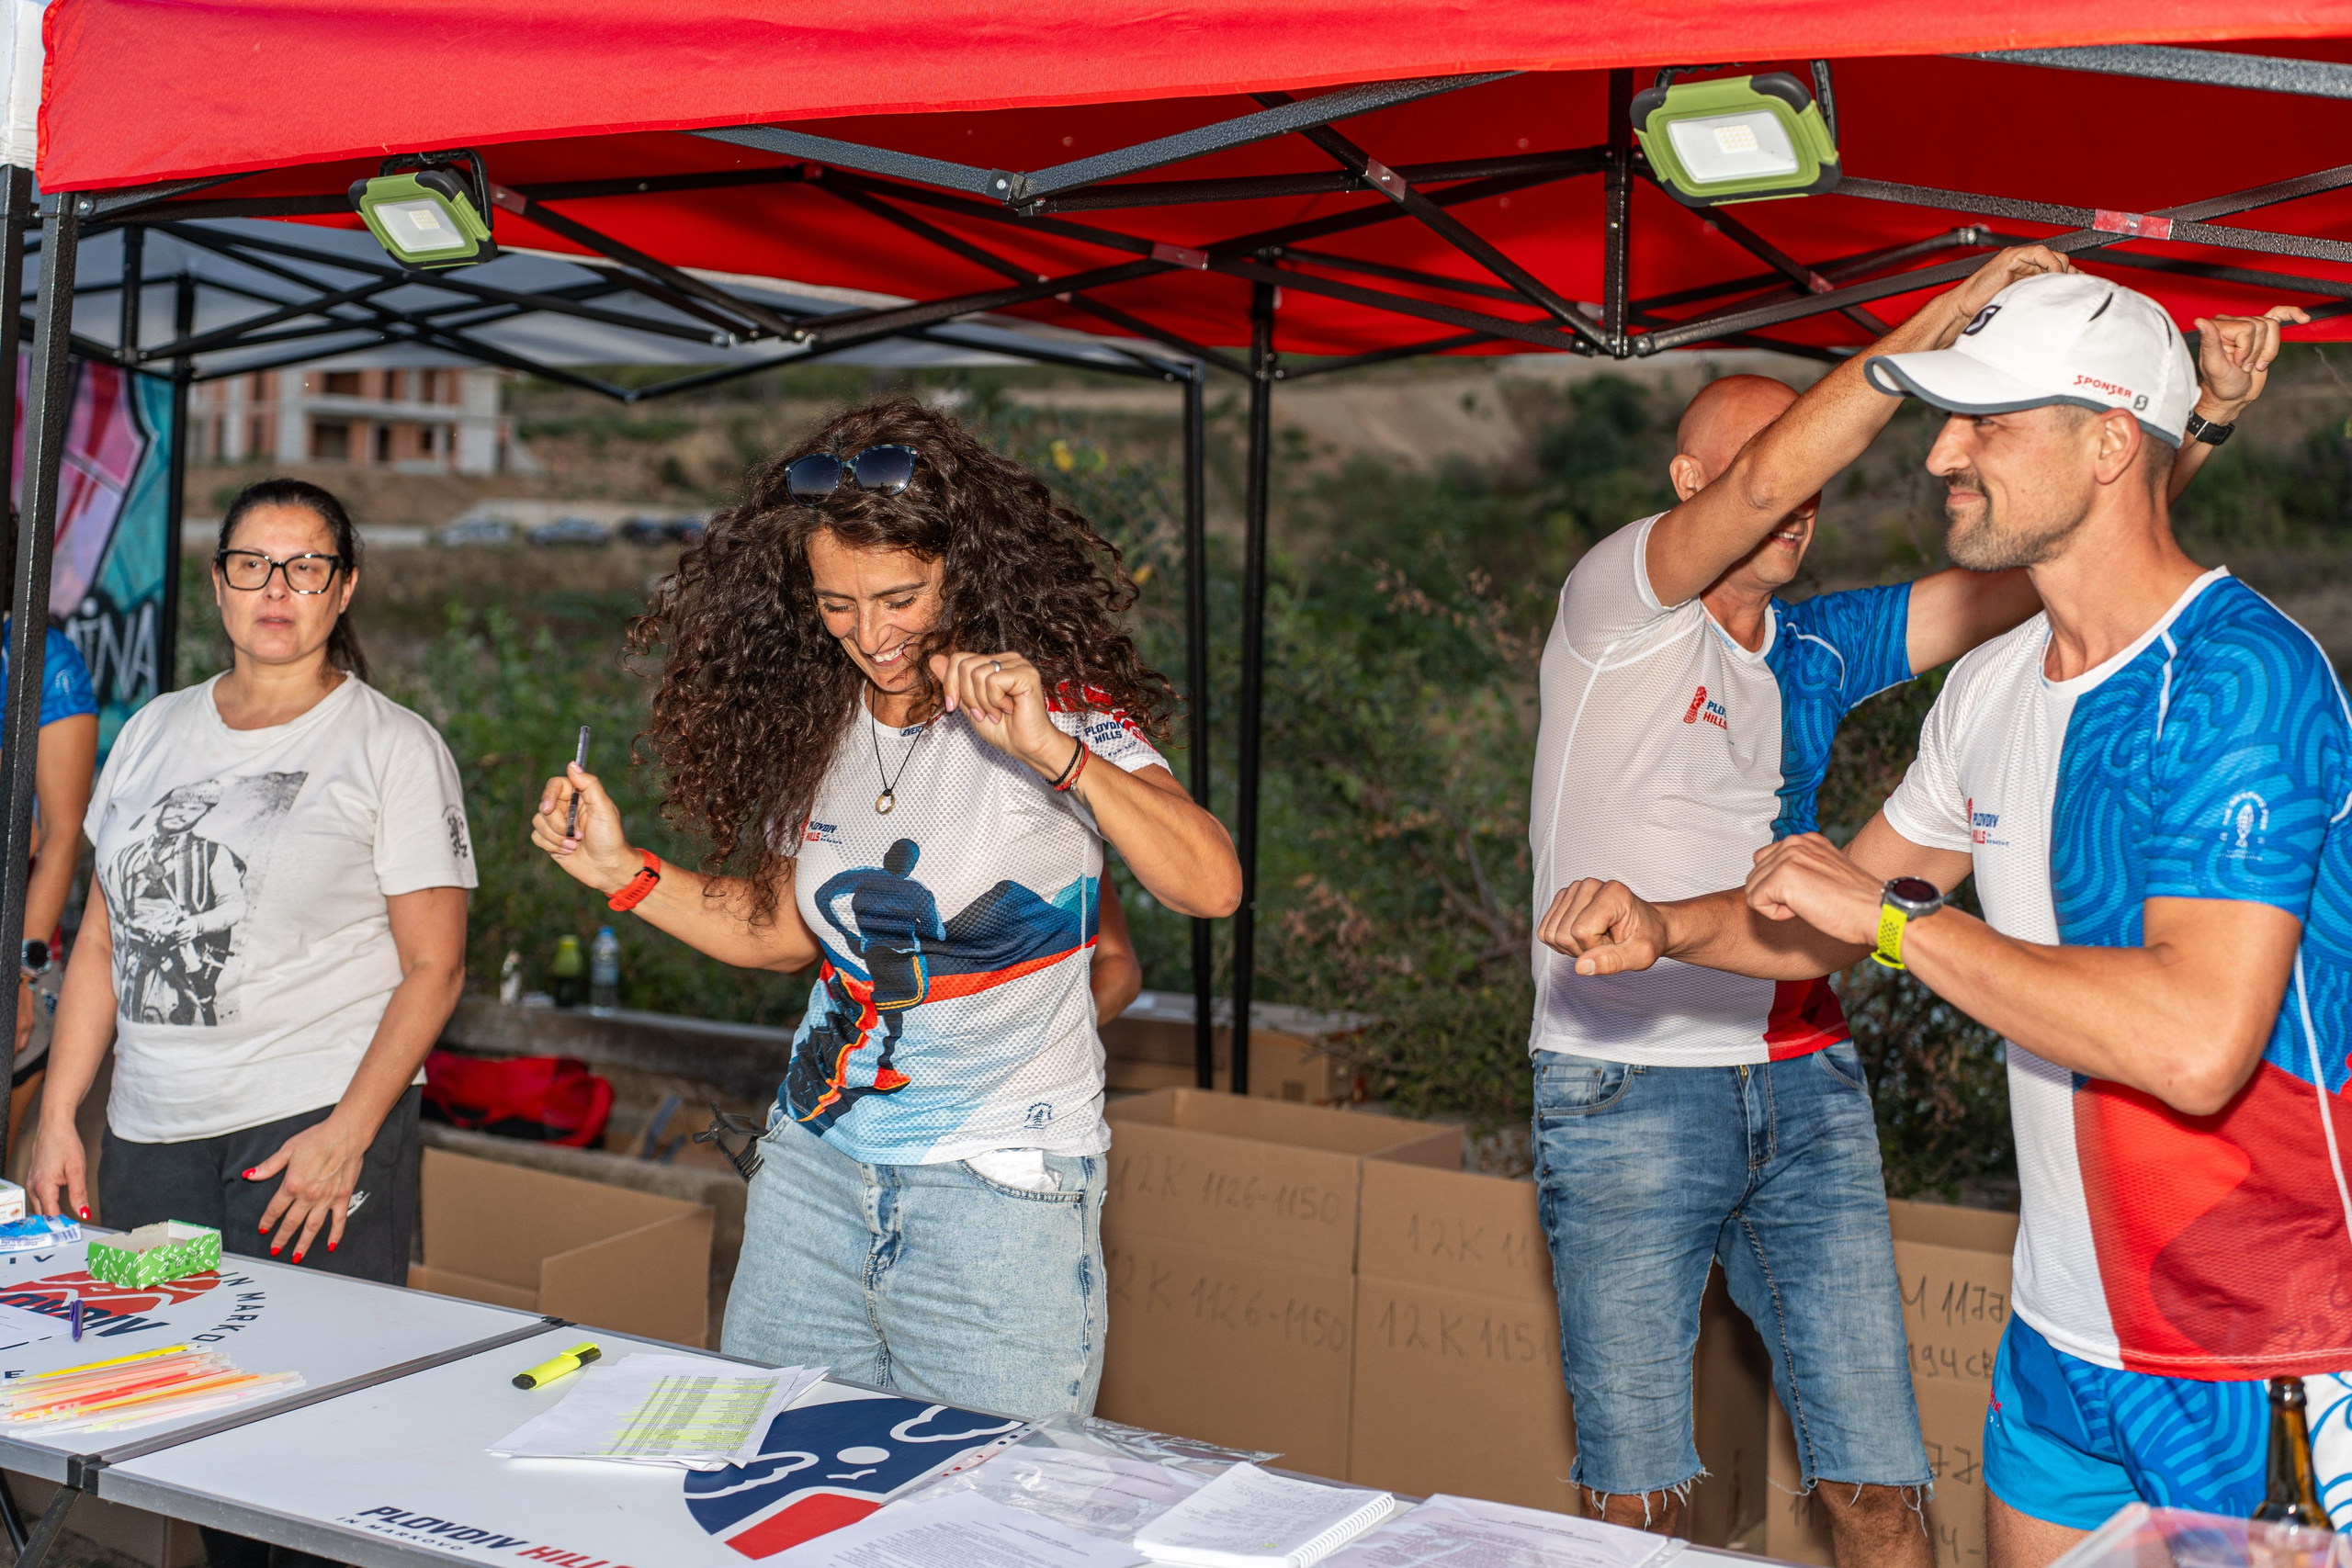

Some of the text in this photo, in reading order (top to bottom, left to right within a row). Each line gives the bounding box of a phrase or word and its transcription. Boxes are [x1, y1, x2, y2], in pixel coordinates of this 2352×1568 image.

[2073, 375, 2132, 399] SPONSER
[1094, 730, 1123, 744] HILLS
[191, 1292, 267, 1343] MARKO
[336, 1517, 465, 1551] IN MARKOVO
[356, 1506, 530, 1550] PLOVDIV
